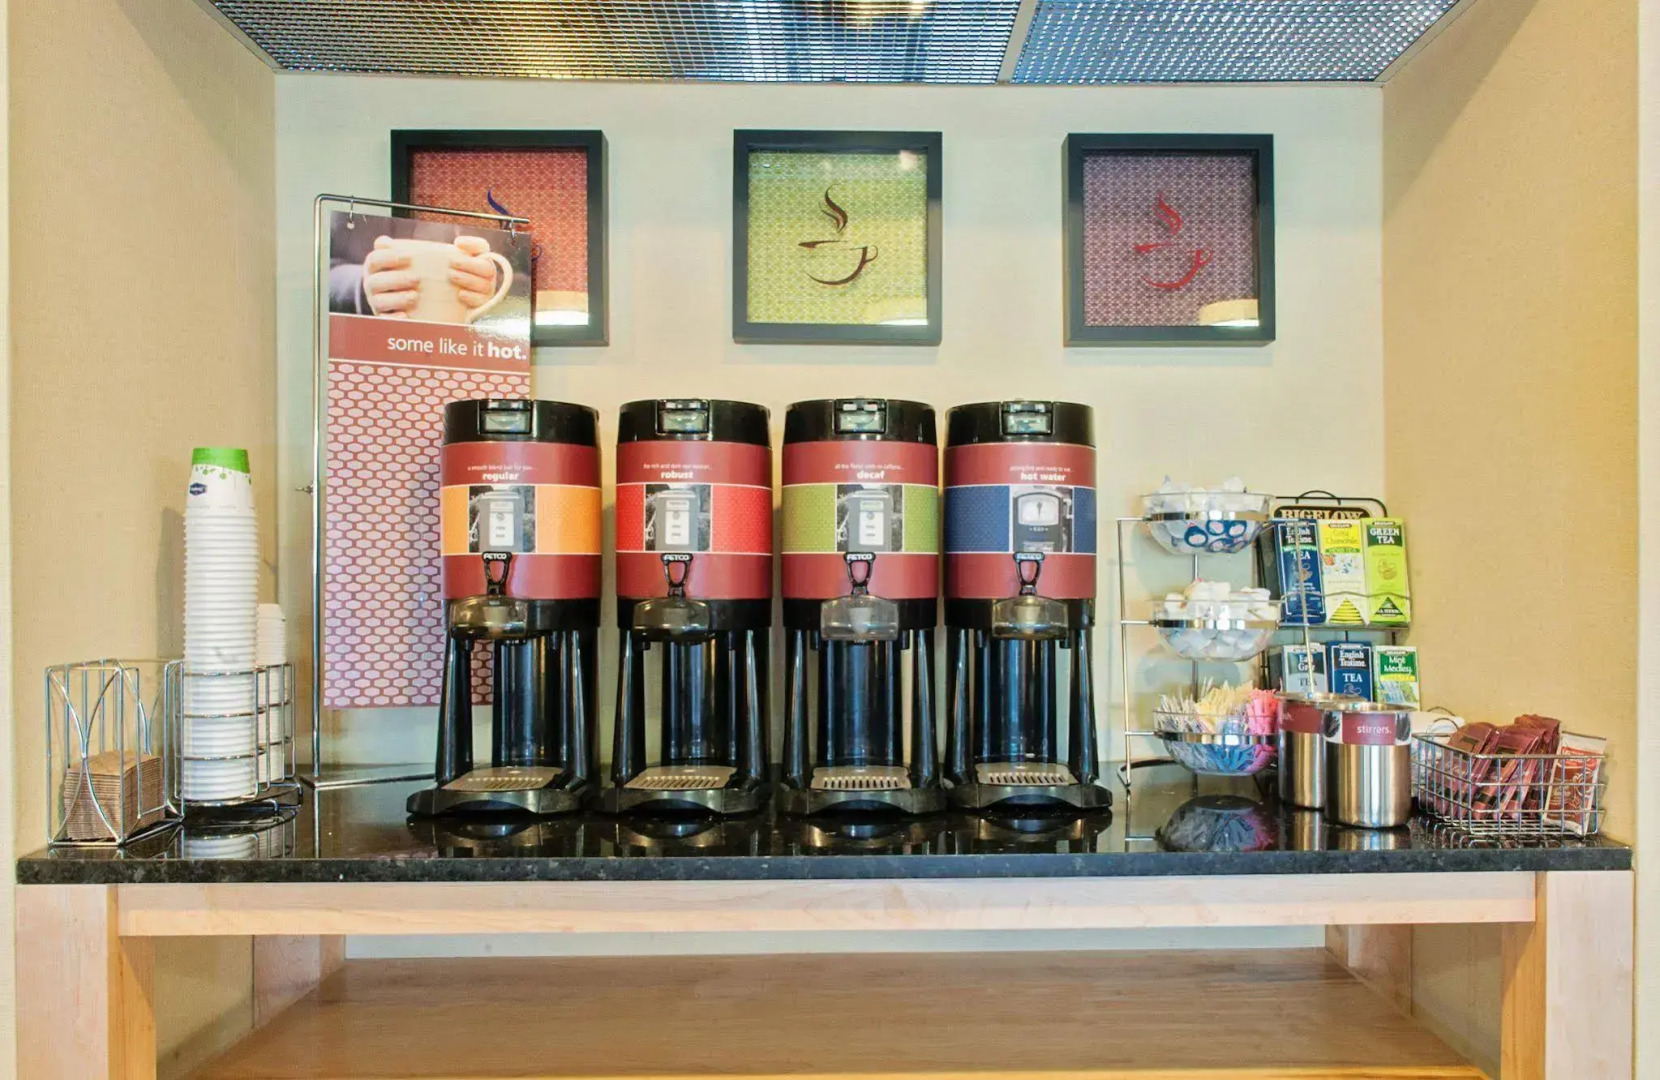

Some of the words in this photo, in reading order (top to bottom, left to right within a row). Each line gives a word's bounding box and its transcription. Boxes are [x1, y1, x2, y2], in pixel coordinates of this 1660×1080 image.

[387, 337, 434, 353] some
[439, 338, 467, 355] like
[473, 341, 484, 357] it
[487, 342, 527, 360] hot.
[482, 471, 520, 483] regular
[660, 470, 694, 479] robust
[856, 470, 885, 480] decaf
[1020, 472, 1037, 481] hot
[1040, 472, 1066, 482] water
[1369, 527, 1400, 536] GREEN
[1376, 535, 1395, 544] TEA
[1339, 649, 1364, 659] English
[1342, 672, 1363, 683] TEA
[1356, 724, 1392, 734] stirrers.
